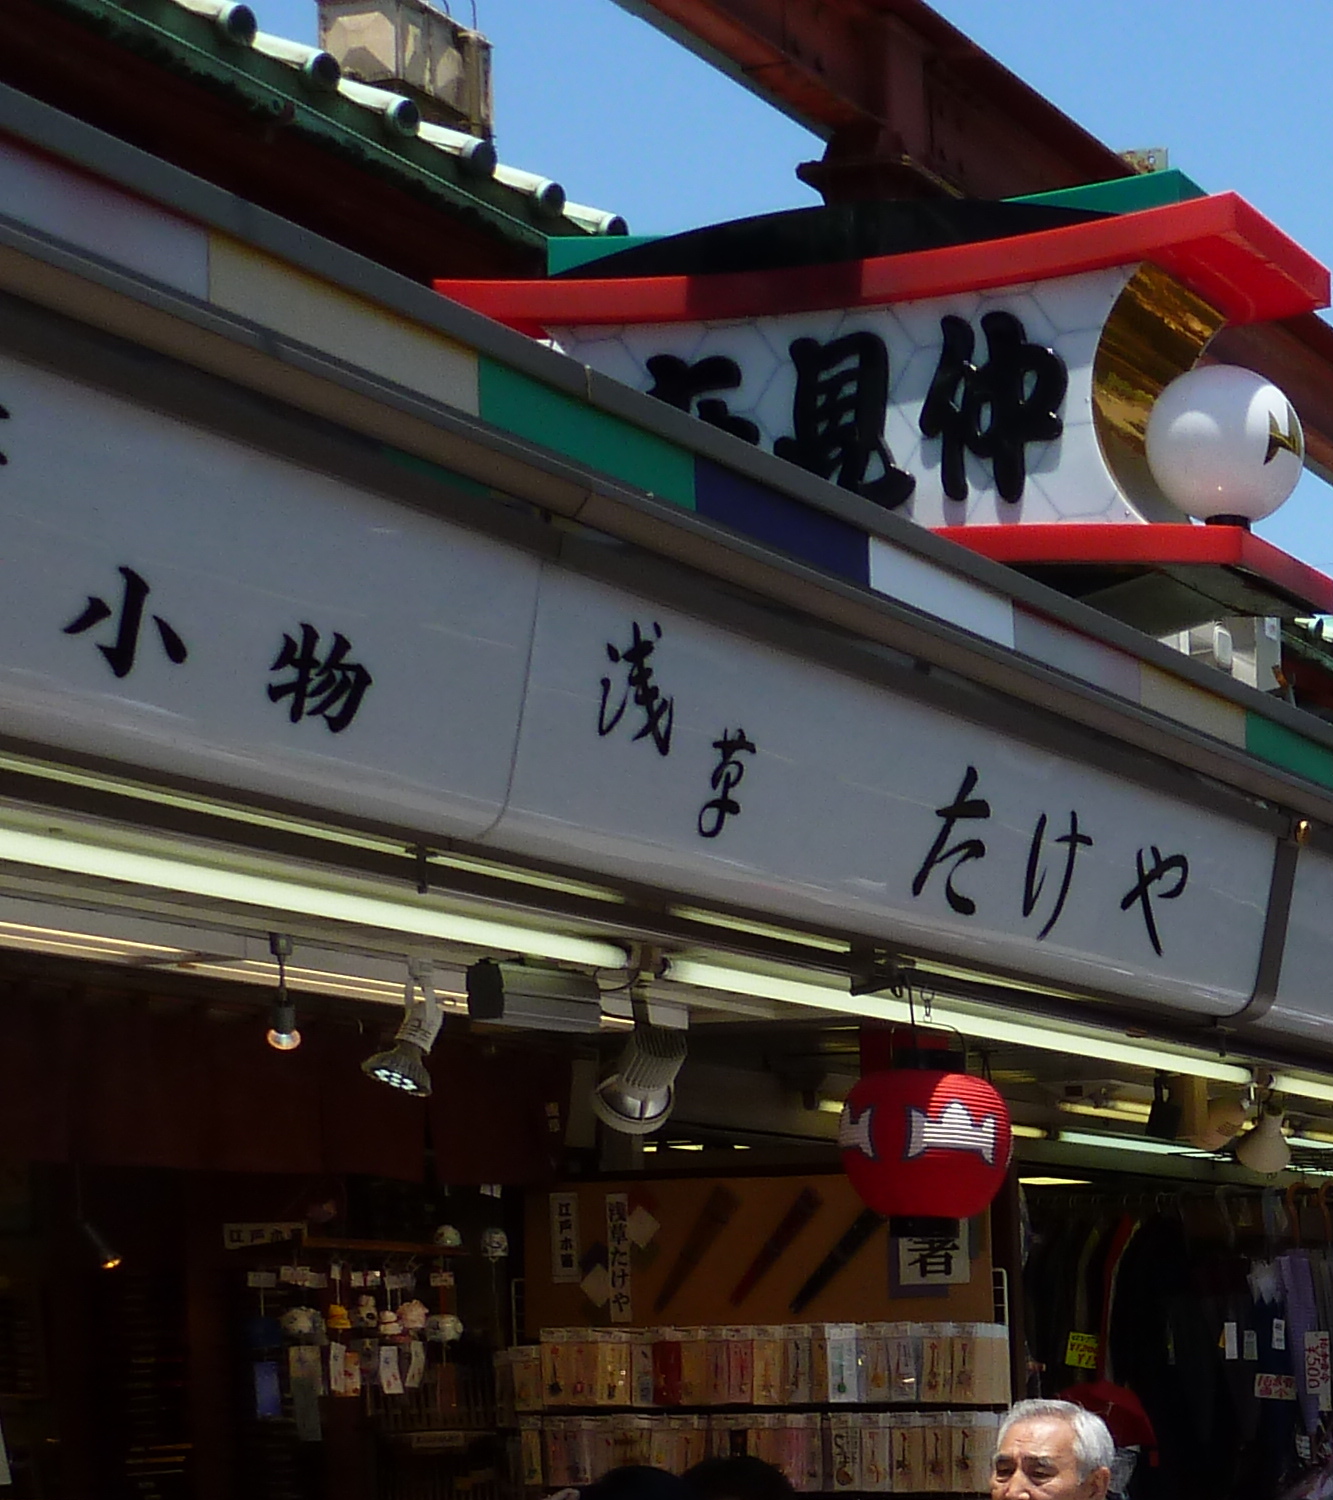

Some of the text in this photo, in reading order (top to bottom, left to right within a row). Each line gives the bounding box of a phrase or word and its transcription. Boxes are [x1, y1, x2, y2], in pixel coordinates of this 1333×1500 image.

[63, 566, 373, 733] 小物
[598, 619, 1190, 957] 浅草 たけや
